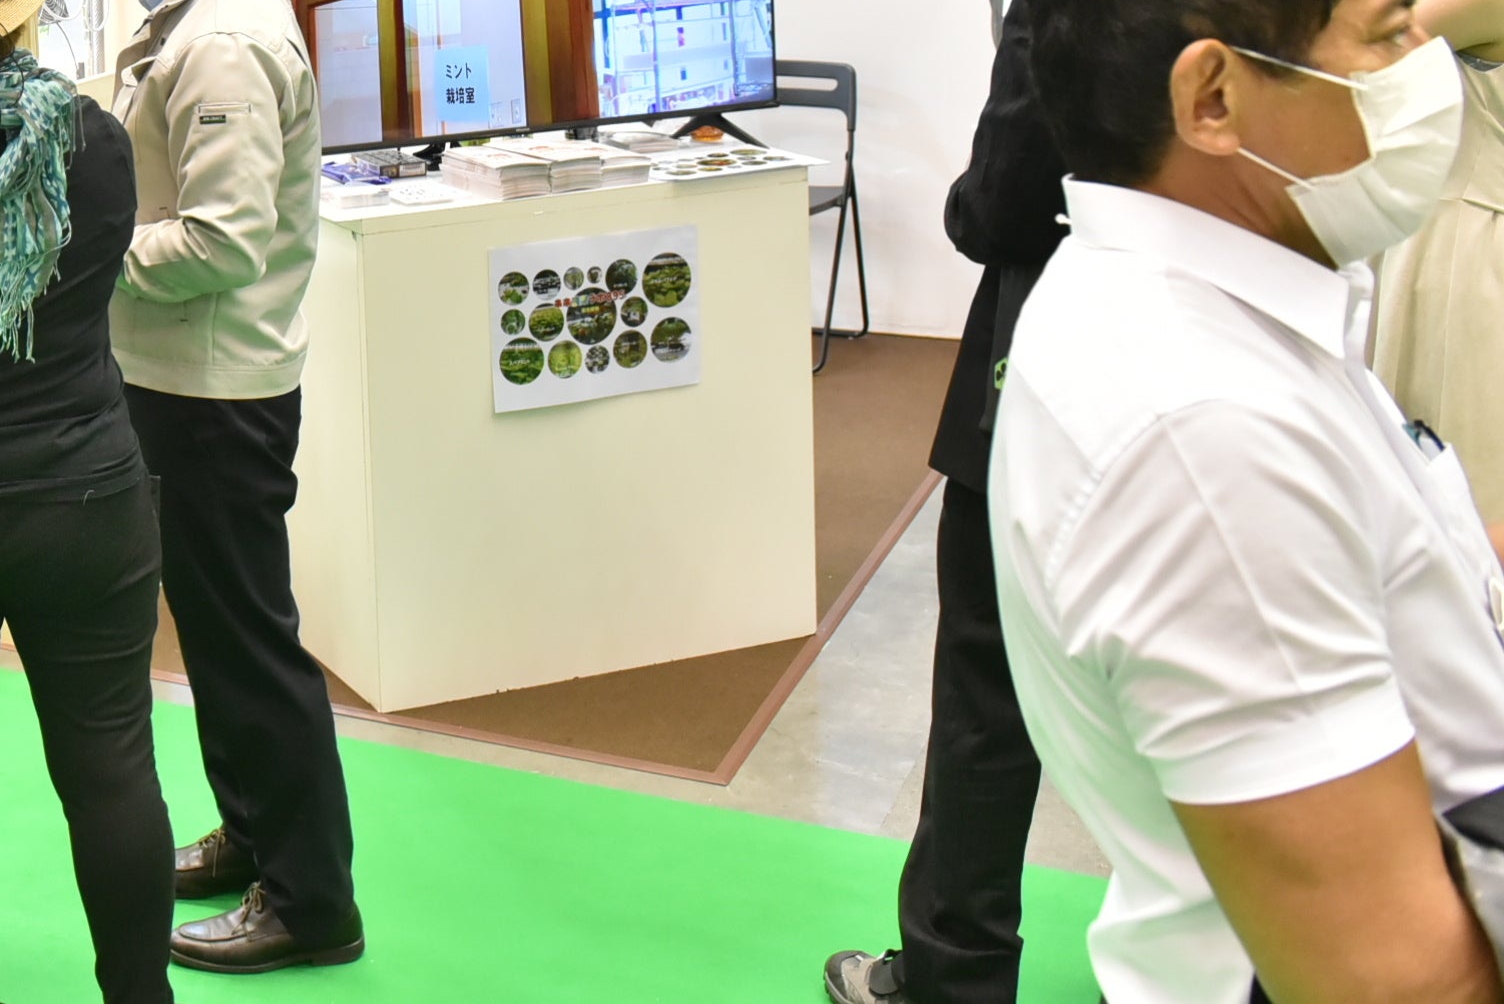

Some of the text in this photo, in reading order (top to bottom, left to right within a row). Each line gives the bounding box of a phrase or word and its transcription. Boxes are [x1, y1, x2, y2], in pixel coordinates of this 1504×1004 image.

[446, 62, 472, 79] ミント
[446, 87, 475, 104] 栽培室
